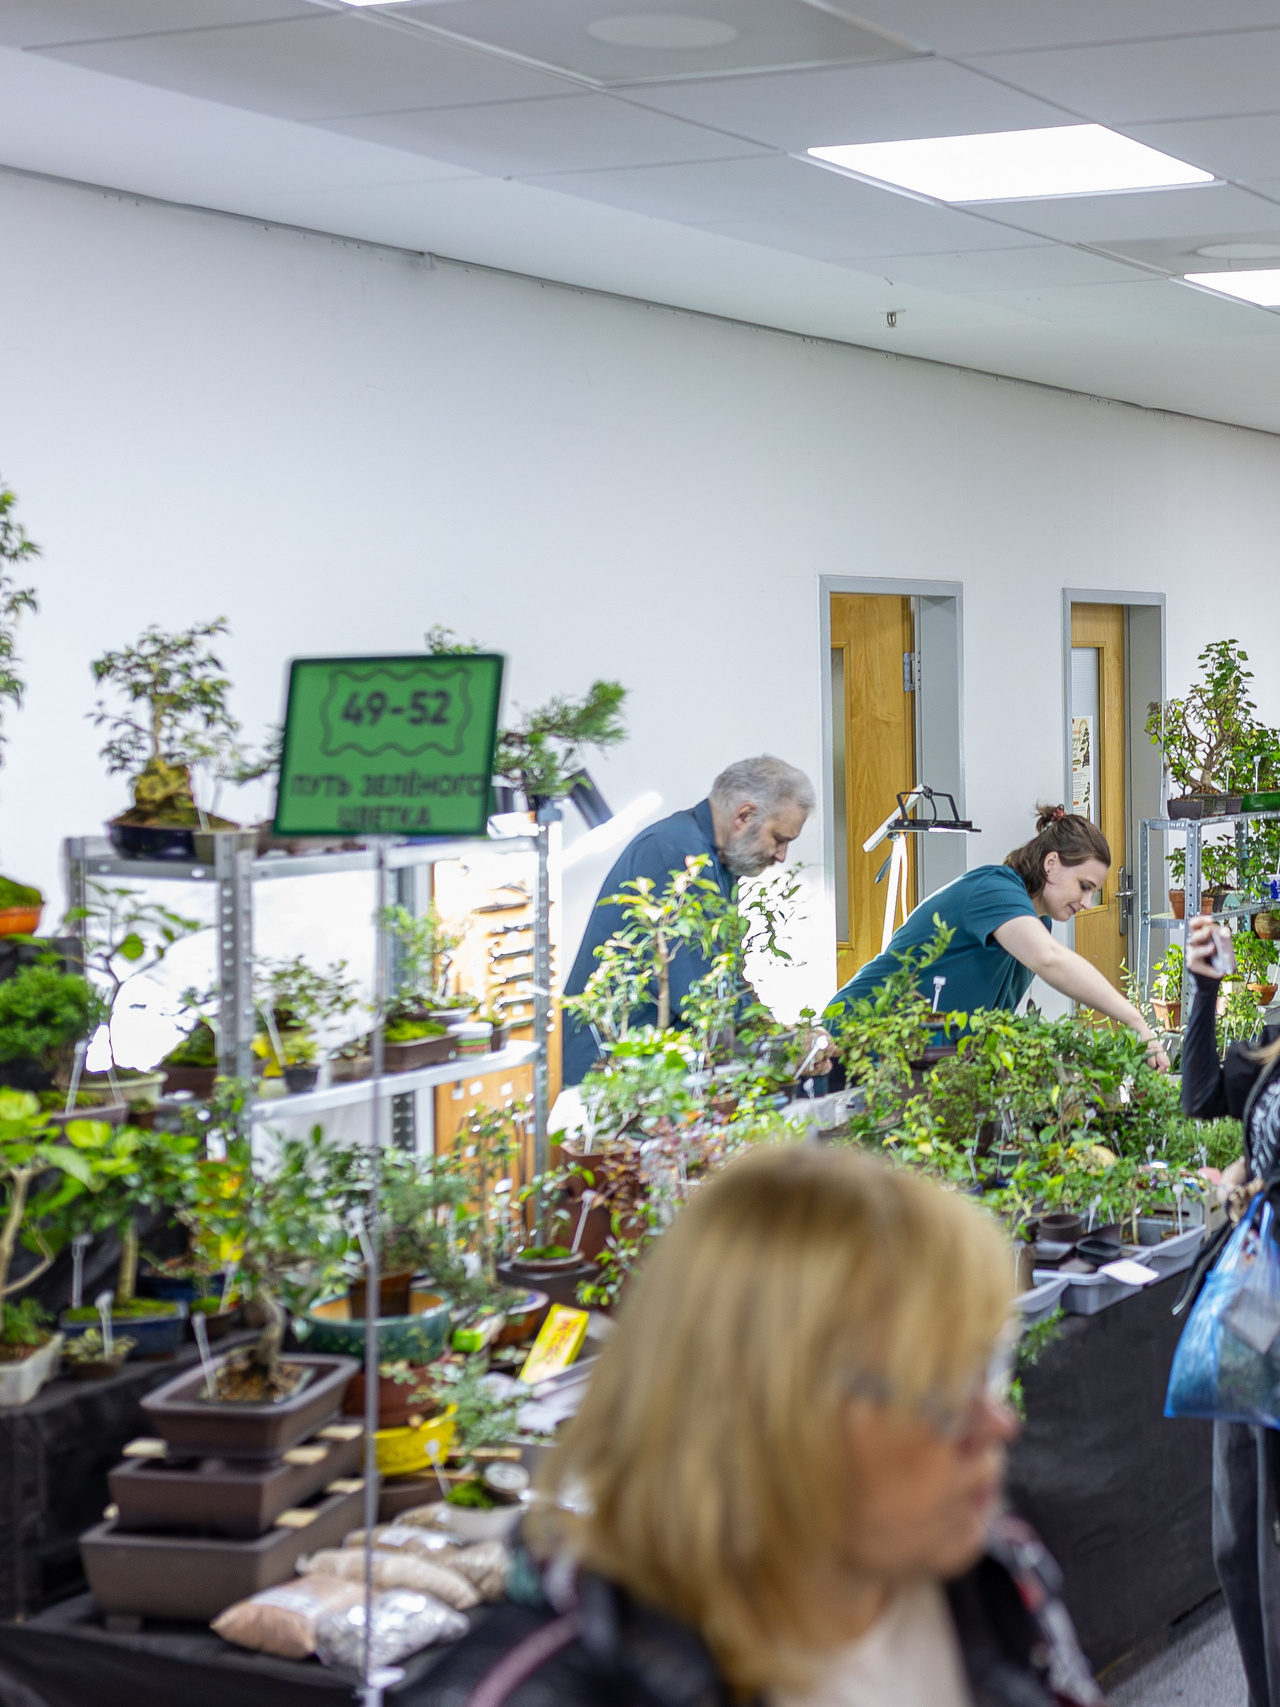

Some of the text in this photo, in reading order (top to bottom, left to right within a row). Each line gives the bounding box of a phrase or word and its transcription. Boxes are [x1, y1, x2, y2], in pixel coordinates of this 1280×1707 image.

[340, 689, 451, 727] 49-52
[291, 768, 486, 798] ПУТЬ ЗЕЛЁНОГО
[337, 804, 431, 830] ЦВЕТКА
